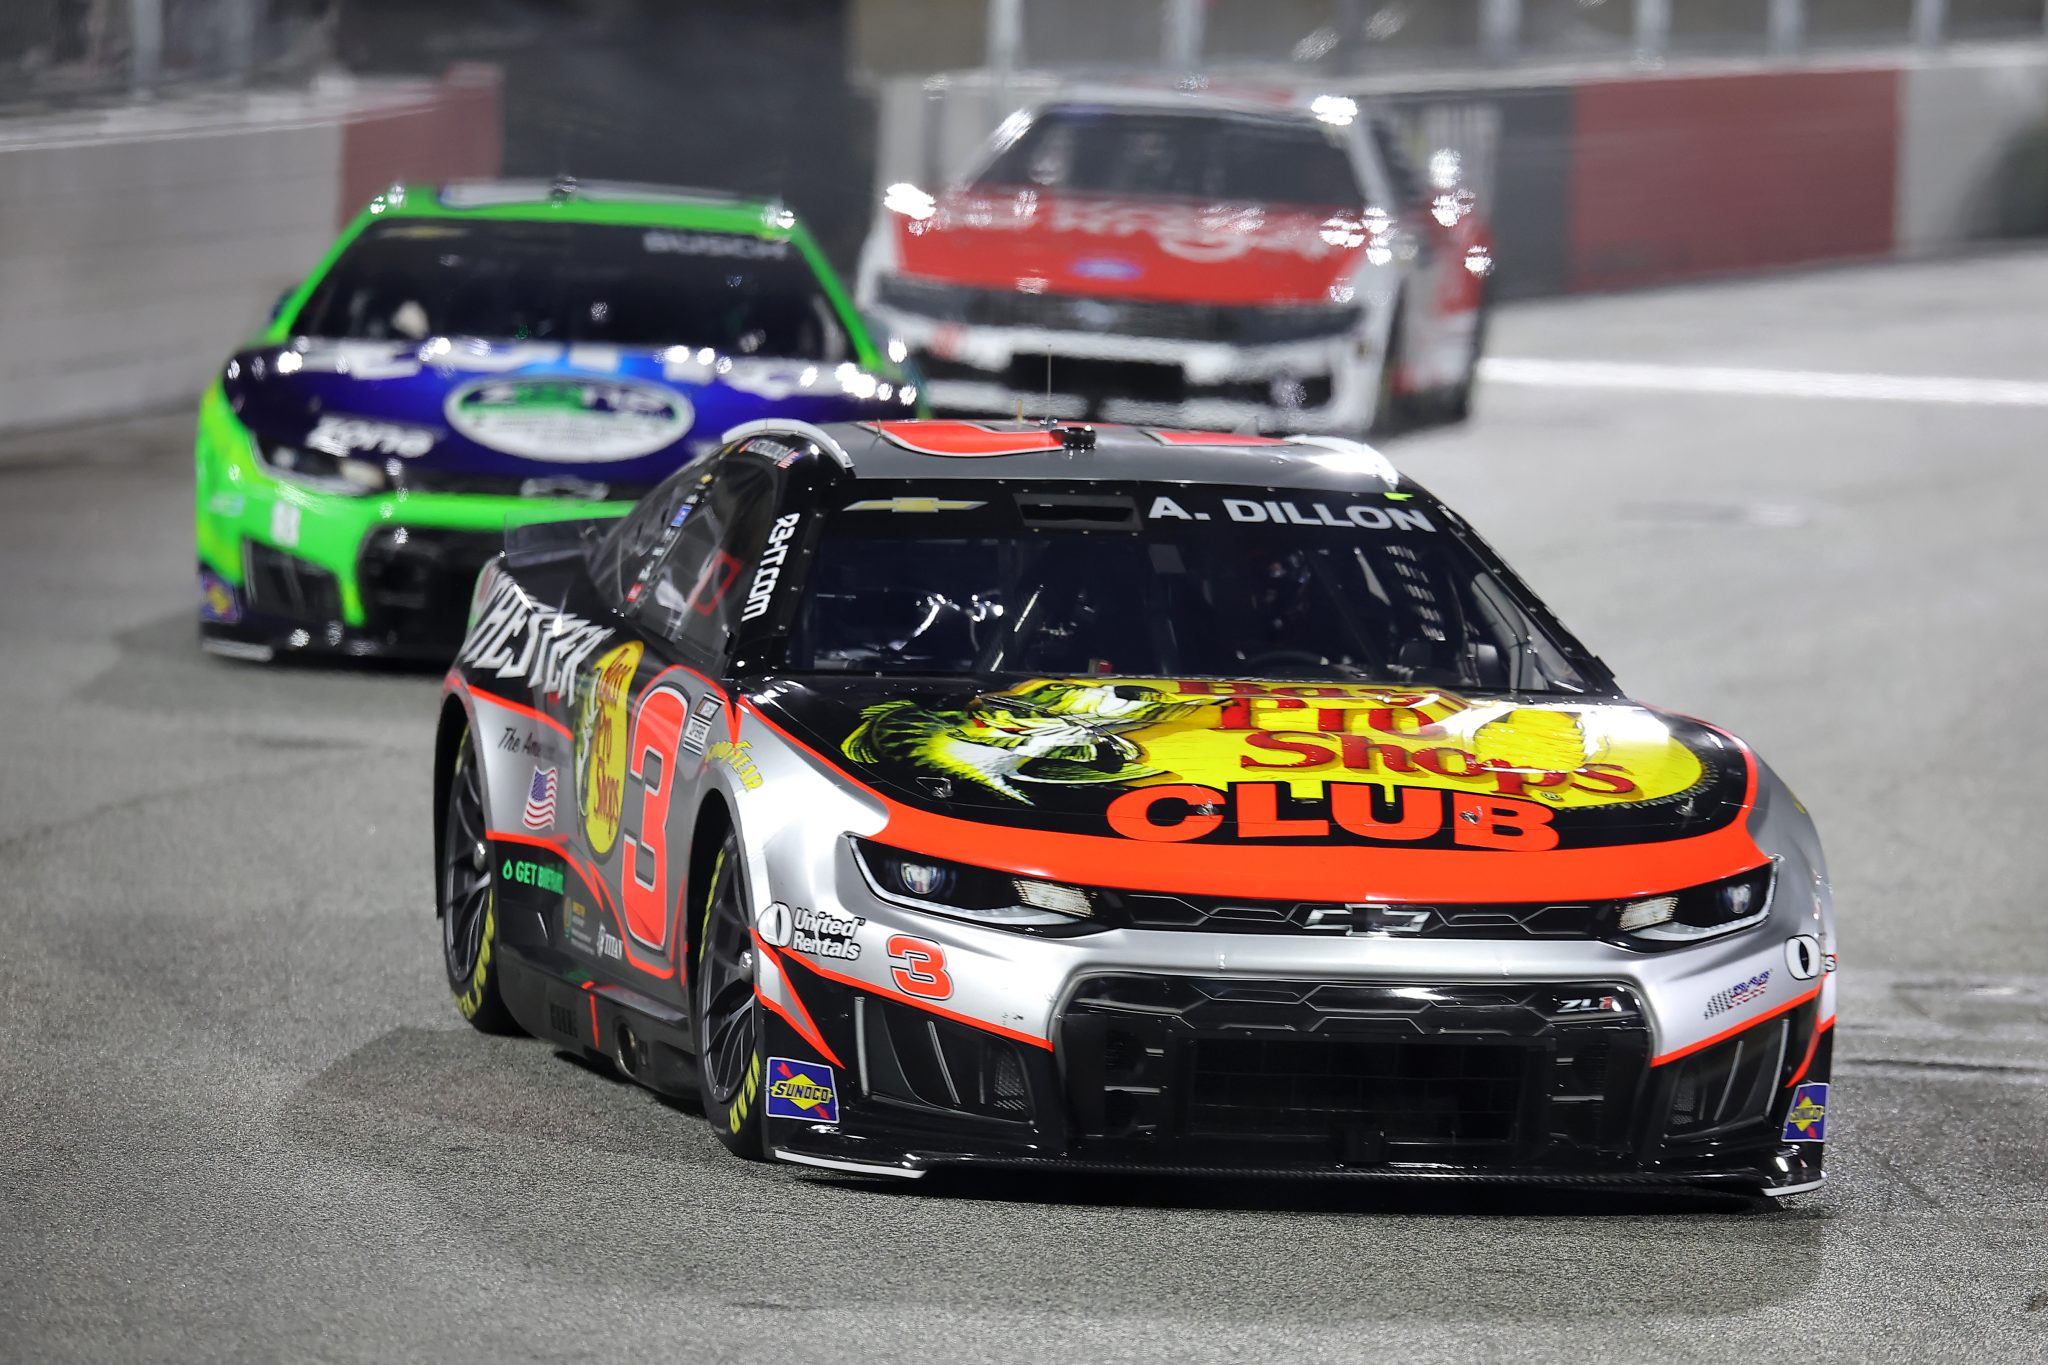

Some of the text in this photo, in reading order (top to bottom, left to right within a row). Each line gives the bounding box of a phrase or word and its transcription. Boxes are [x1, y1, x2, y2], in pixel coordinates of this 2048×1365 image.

[1148, 496, 1438, 532] A. DILLON
[1240, 730, 1637, 797] Shops
[621, 684, 689, 952] 3
[1106, 781, 1560, 853] CLUB
[515, 860, 538, 886] GET
[793, 908, 862, 939] United
[792, 930, 862, 961] Rentals
[887, 934, 954, 1001] 3
[774, 1082, 830, 1102] SUNOCO
